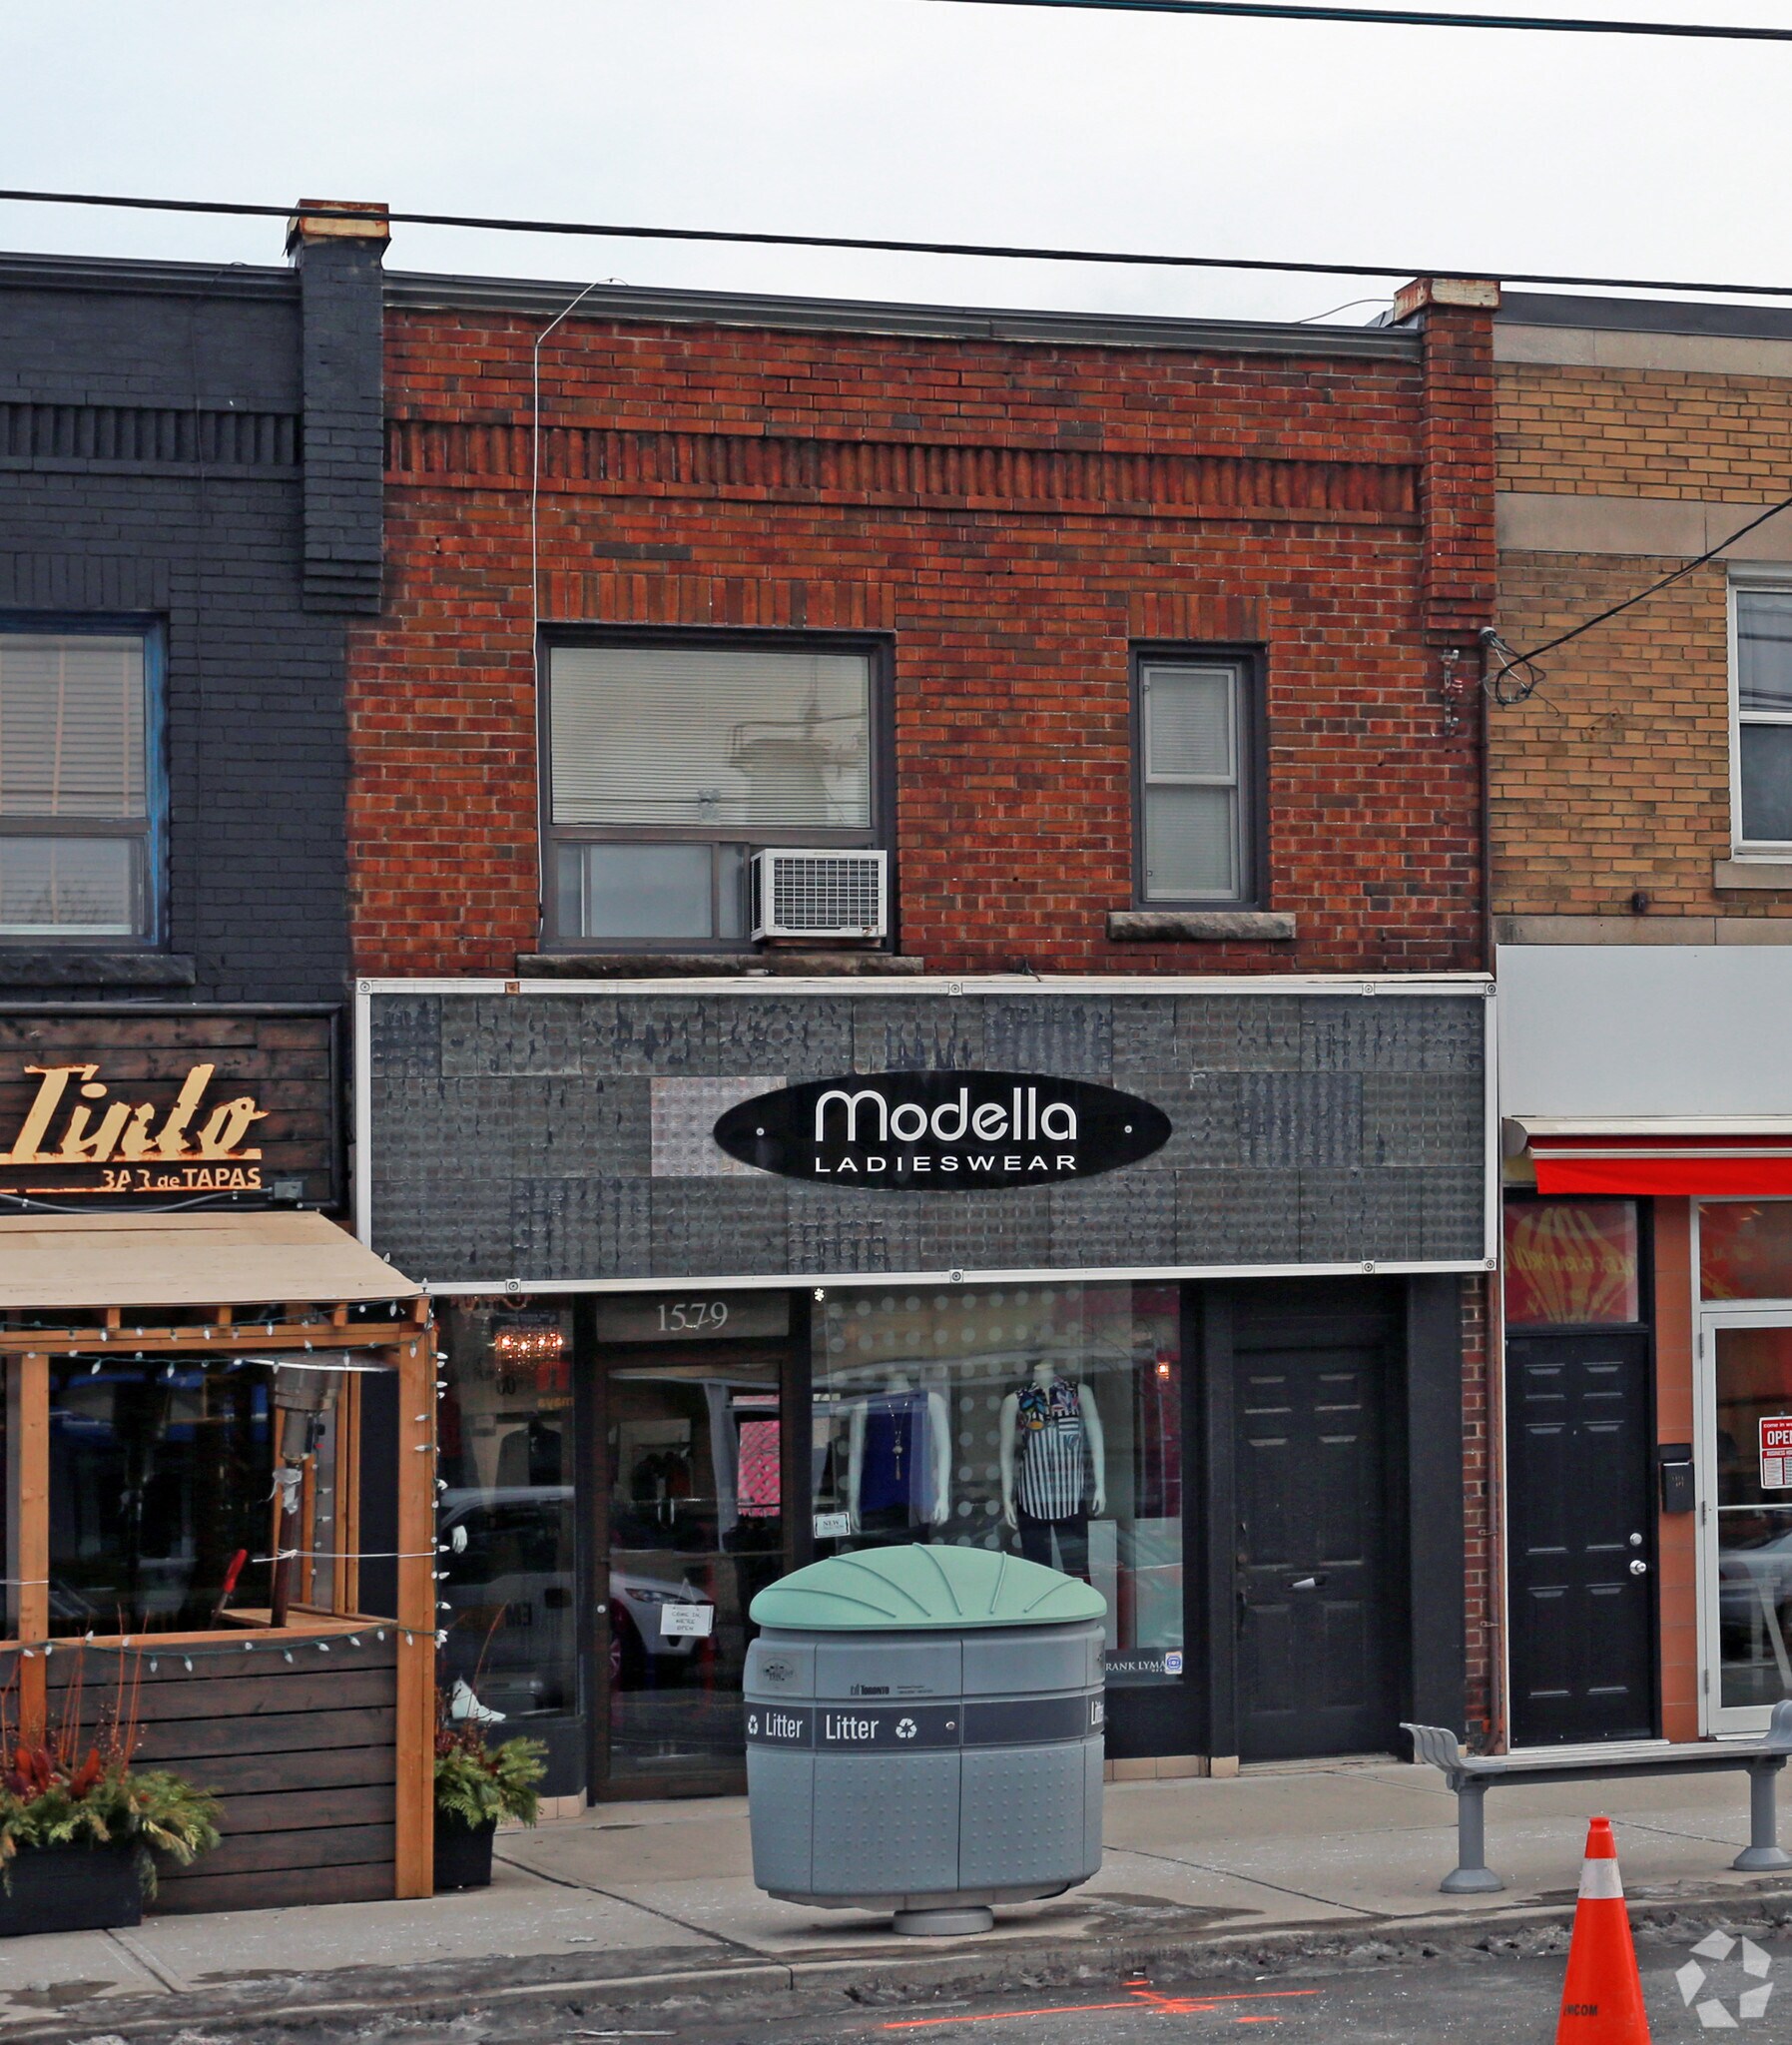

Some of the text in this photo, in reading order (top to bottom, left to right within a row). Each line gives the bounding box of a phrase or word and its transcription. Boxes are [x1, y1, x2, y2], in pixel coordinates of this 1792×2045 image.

[815, 1087, 1077, 1141] Modella
[815, 1154, 1077, 1173] LADIESWEAR
[157, 1174, 180, 1188] de
[182, 1166, 262, 1188] TAPAS
[658, 1302, 728, 1331] 1579
[1105, 1660, 1166, 1672] RANK LYMA
[766, 1711, 803, 1737] Litter
[826, 1713, 880, 1739] Litter
